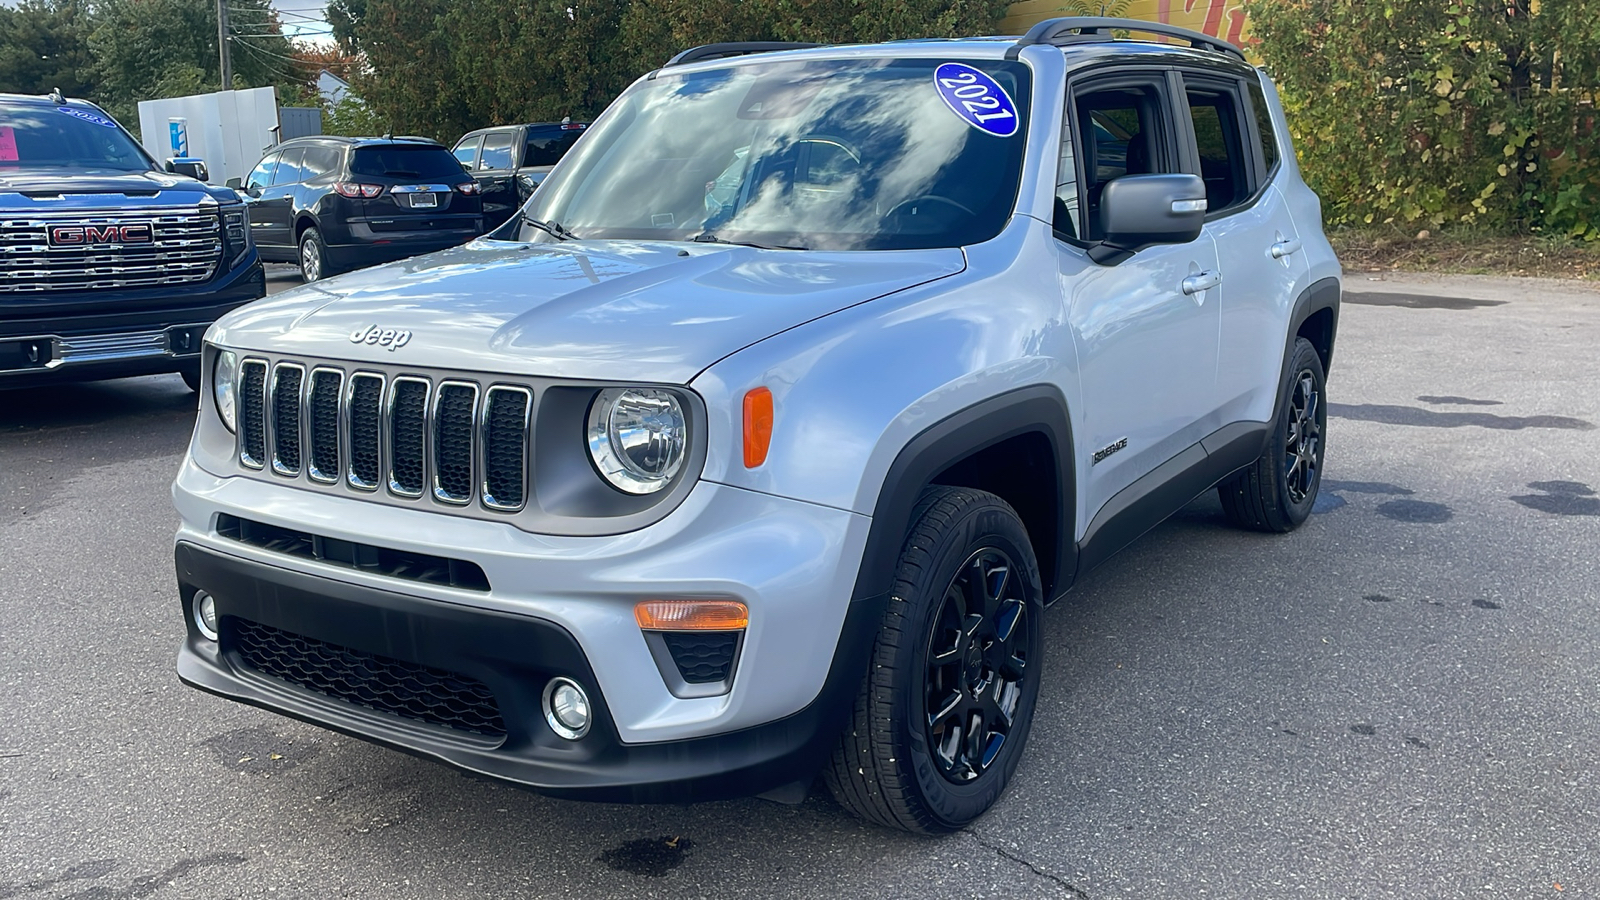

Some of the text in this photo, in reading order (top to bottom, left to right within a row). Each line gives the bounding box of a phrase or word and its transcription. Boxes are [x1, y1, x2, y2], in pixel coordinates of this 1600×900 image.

[939, 73, 1013, 124] 2021
[53, 225, 149, 244] GMC
[349, 324, 412, 352] Jeep
[1091, 437, 1128, 467] RENEGADE
